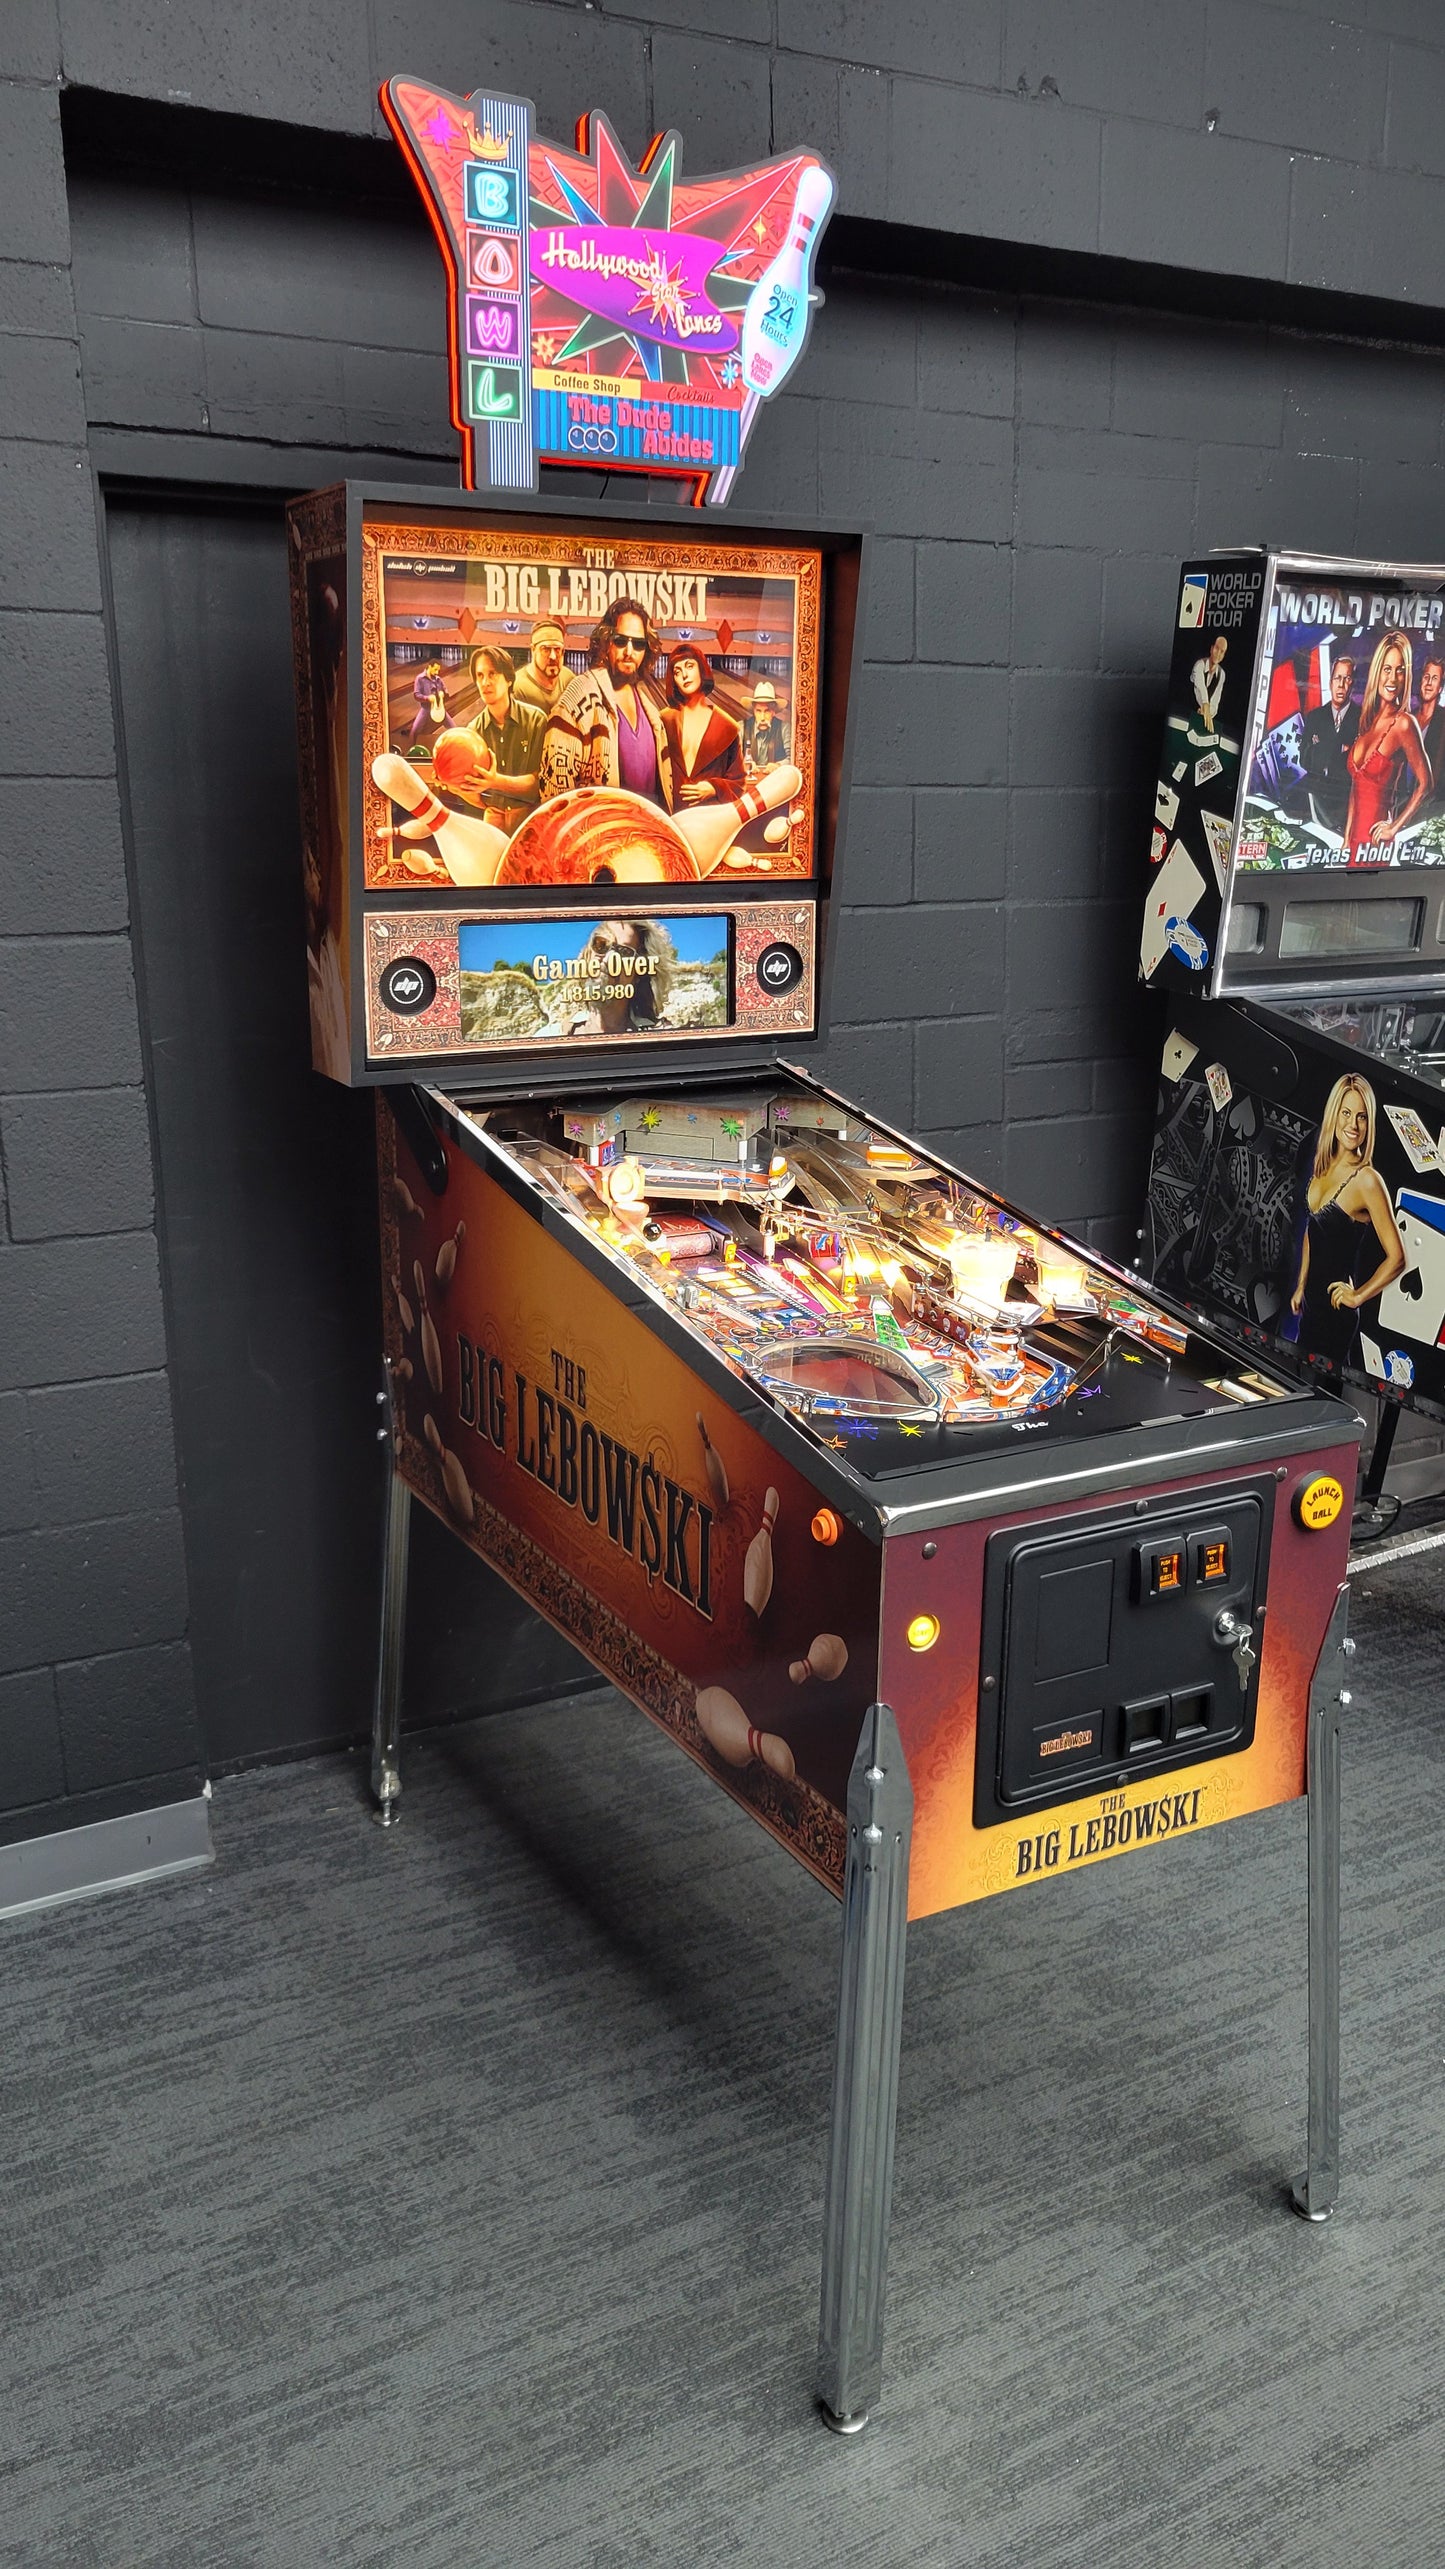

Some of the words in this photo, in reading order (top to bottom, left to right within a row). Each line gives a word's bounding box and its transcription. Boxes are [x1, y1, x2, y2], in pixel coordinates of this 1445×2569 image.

[541, 231, 663, 281] Hollywood
[651, 281, 680, 303] Star
[773, 284, 798, 306] Open
[675, 303, 722, 339] Lanes
[764, 296, 795, 330] 24
[761, 319, 788, 344] Hours
[554, 374, 589, 391] Coffee
[593, 379, 621, 396] Shop
[667, 386, 715, 404] Cocktails
[568, 395, 611, 425] The
[617, 402, 672, 432] Dude
[643, 429, 713, 460] Abides
[582, 547, 615, 569] THE
[484, 564, 541, 615] BIG
[1210, 572, 1262, 590] WORLD
[1208, 591, 1255, 609] POKER
[1279, 592, 1363, 625] WORLD
[1369, 594, 1444, 629] POKER
[1206, 610, 1243, 628] TOUR
[1305, 843, 1351, 864] Texas
[1355, 841, 1392, 863] Hold
[532, 954, 600, 981] Game
[608, 951, 660, 978] Over
[560, 984, 635, 1003] 1,815,980
[551, 1348, 587, 1410] THE
[457, 1332, 507, 1454] BIG
[1306, 1486, 1341, 1507] LAUNCH
[1312, 1508, 1332, 1520] BALL
[1100, 1793, 1126, 1814] THE
[1016, 1829, 1062, 1878] BIG
